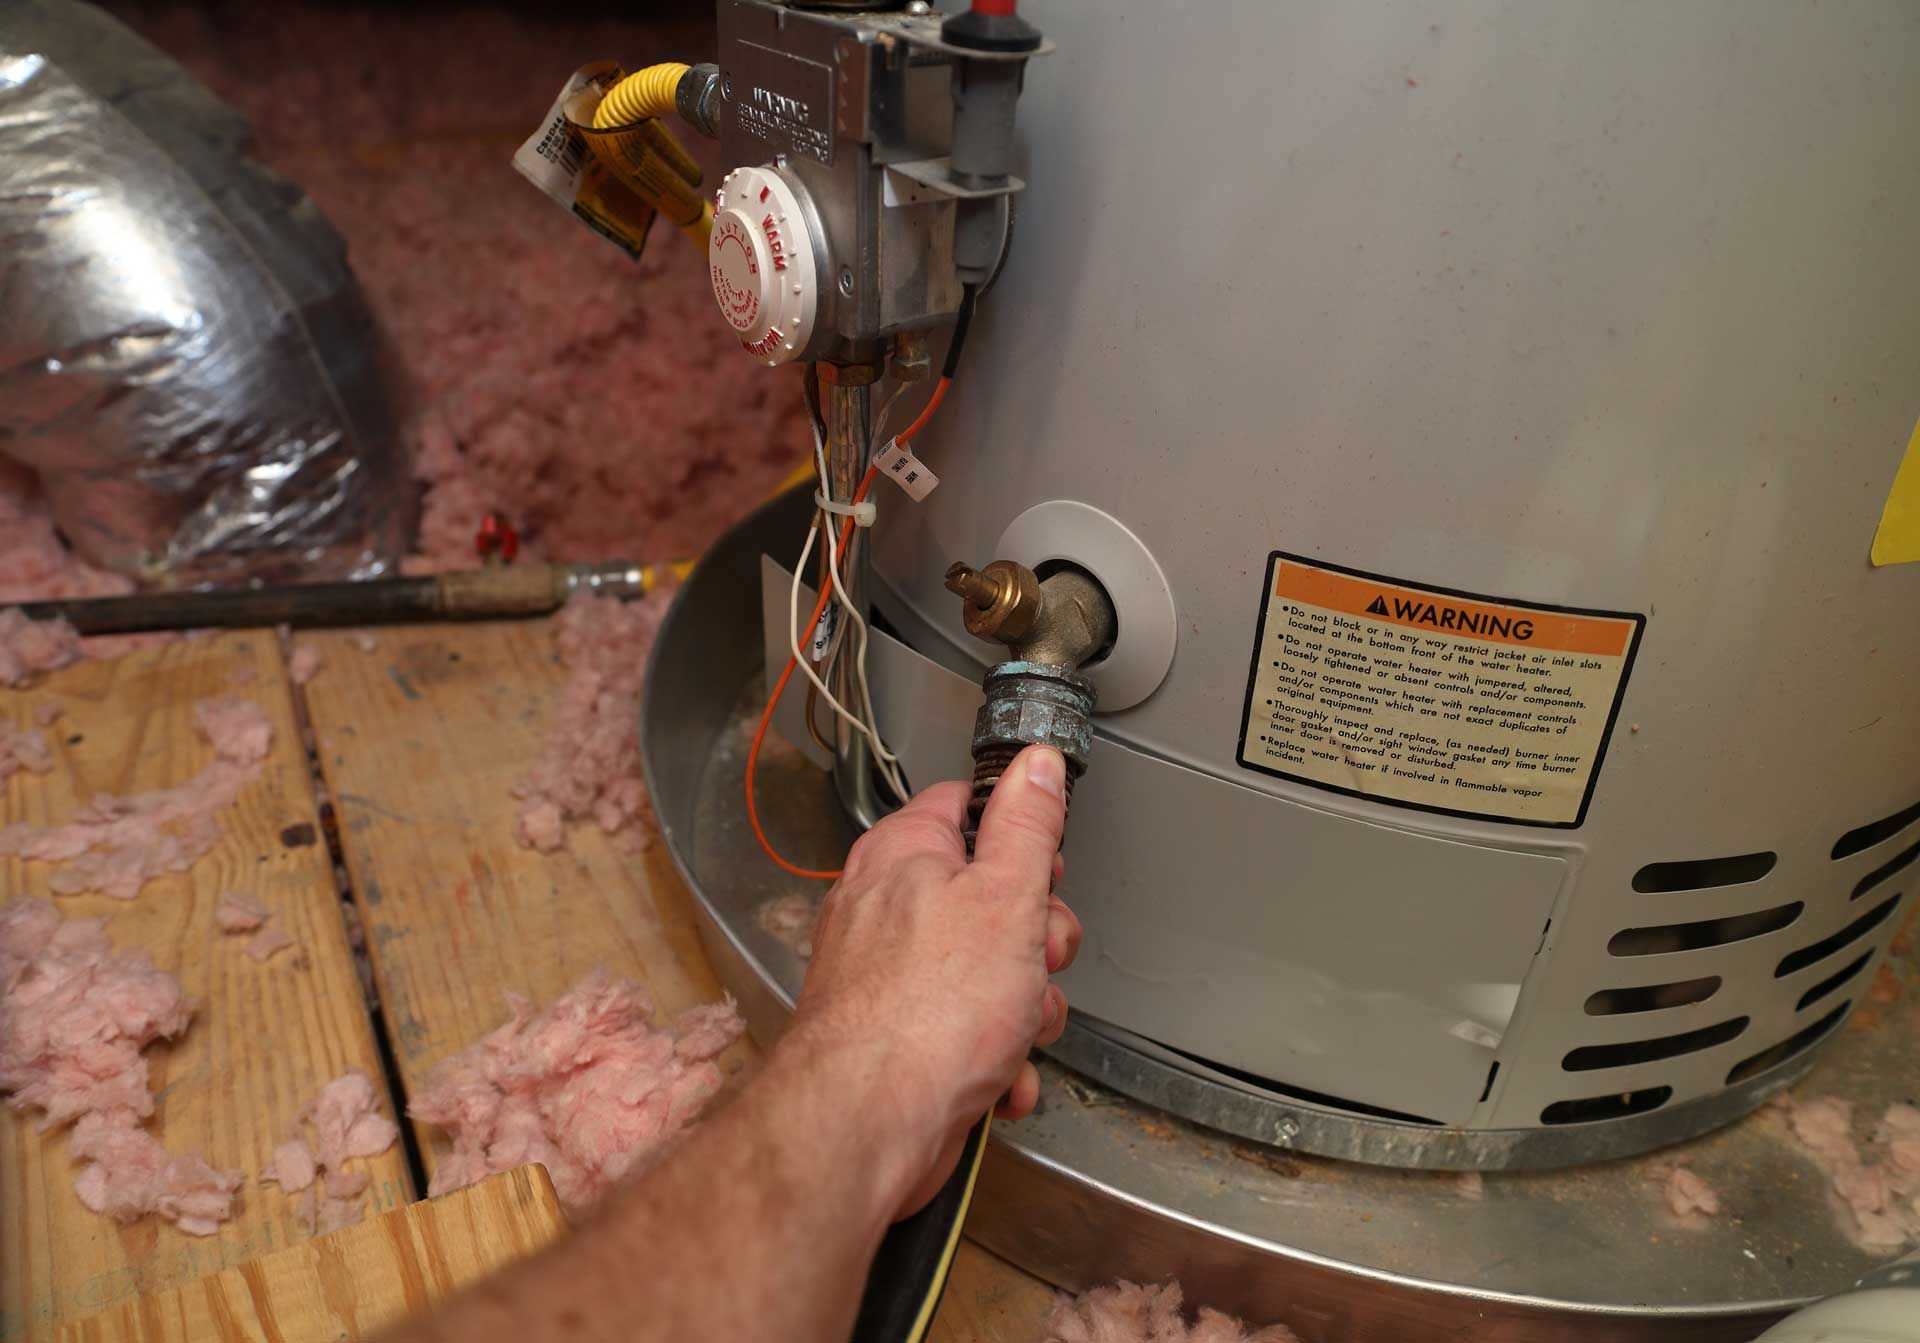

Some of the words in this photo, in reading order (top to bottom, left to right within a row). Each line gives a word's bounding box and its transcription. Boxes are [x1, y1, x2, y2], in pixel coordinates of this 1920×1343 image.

[714, 223, 758, 275] CAUTION
[762, 213, 786, 272] WARM
[1288, 618, 1326, 635] located
[1331, 630, 1342, 639] at
[1347, 632, 1363, 644] the
[1369, 637, 1405, 653] bottom
[1411, 646, 1436, 659] front
[1458, 655, 1474, 666] the
[1481, 661, 1510, 672] water
[1516, 665, 1552, 677] heater.
[1291, 607, 1305, 617] Do
[1311, 614, 1328, 623] not
[1333, 617, 1361, 631] block
[1367, 626, 1378, 635] or
[1384, 628, 1394, 638] in
[1400, 634, 1419, 646] any
[1426, 640, 1447, 650] way
[1454, 642, 1489, 656] restrict
[1494, 649, 1526, 662] jacket
[1532, 655, 1547, 664] air
[1552, 657, 1574, 667] inlet
[1580, 661, 1602, 670] slots
[1394, 598, 1534, 641] WARNING
[1281, 661, 1295, 673] Do
[1301, 669, 1317, 679] not
[1323, 675, 1361, 690] operate
[1368, 685, 1397, 697] water
[1403, 691, 1436, 705] heater
[1442, 700, 1462, 710] with
[1468, 704, 1532, 720] replacement
[1537, 712, 1577, 724] controls
[1284, 646, 1319, 663] loosely
[1324, 657, 1372, 674] tightened
[1377, 669, 1388, 678] or
[1394, 673, 1428, 686] absent
[1434, 681, 1474, 695] controls
[1481, 689, 1518, 701] and/or
[1523, 695, 1586, 709] components.
[1286, 634, 1300, 646] Do
[1306, 641, 1322, 651] not
[1328, 646, 1367, 662] operate
[1374, 657, 1403, 669] water
[1408, 662, 1442, 678] heater
[1449, 671, 1469, 683] with
[1475, 675, 1527, 691] jumpered,
[1533, 684, 1572, 697] altered,
[1277, 685, 1314, 701] original
[1320, 698, 1374, 716] equipment.
[1279, 674, 1314, 689] and/or
[1320, 685, 1379, 705] components
[1385, 700, 1414, 713] which
[1420, 708, 1437, 717] are
[1443, 711, 1460, 721] not
[1466, 715, 1494, 726] exact
[1499, 718, 1550, 734] duplicates
[1556, 726, 1568, 735] of
[1266, 747, 1305, 765] incident.
[1271, 722, 1295, 734] inner
[1300, 729, 1324, 743] door
[1329, 735, 1336, 745] is
[1342, 743, 1384, 757] removed
[1391, 752, 1402, 760] or
[1407, 754, 1456, 771] disturbed.
[1272, 711, 1296, 724] door
[1301, 721, 1333, 734] gasket
[1338, 728, 1374, 743] and/or
[1379, 738, 1403, 749] sight
[1408, 744, 1447, 758] window
[1453, 752, 1486, 764] gasket
[1492, 758, 1510, 769] any
[1516, 760, 1537, 770] time
[1543, 763, 1576, 774] burner
[1274, 701, 1329, 723] Thoroughly
[1334, 716, 1369, 730] inspect
[1374, 725, 1393, 736] and
[1399, 731, 1439, 747] replace,
[1446, 737, 1461, 749] (as
[1467, 742, 1510, 757] needed)
[1516, 748, 1549, 762] burner
[1554, 753, 1580, 764] inner
[1268, 737, 1306, 753] Replace
[1311, 750, 1340, 762] water
[1344, 756, 1376, 771] heater
[1381, 765, 1389, 773] if
[1393, 767, 1435, 783] involved
[1440, 776, 1449, 785] in
[1455, 777, 1507, 793] flammable
[1513, 787, 1543, 798] vapor
